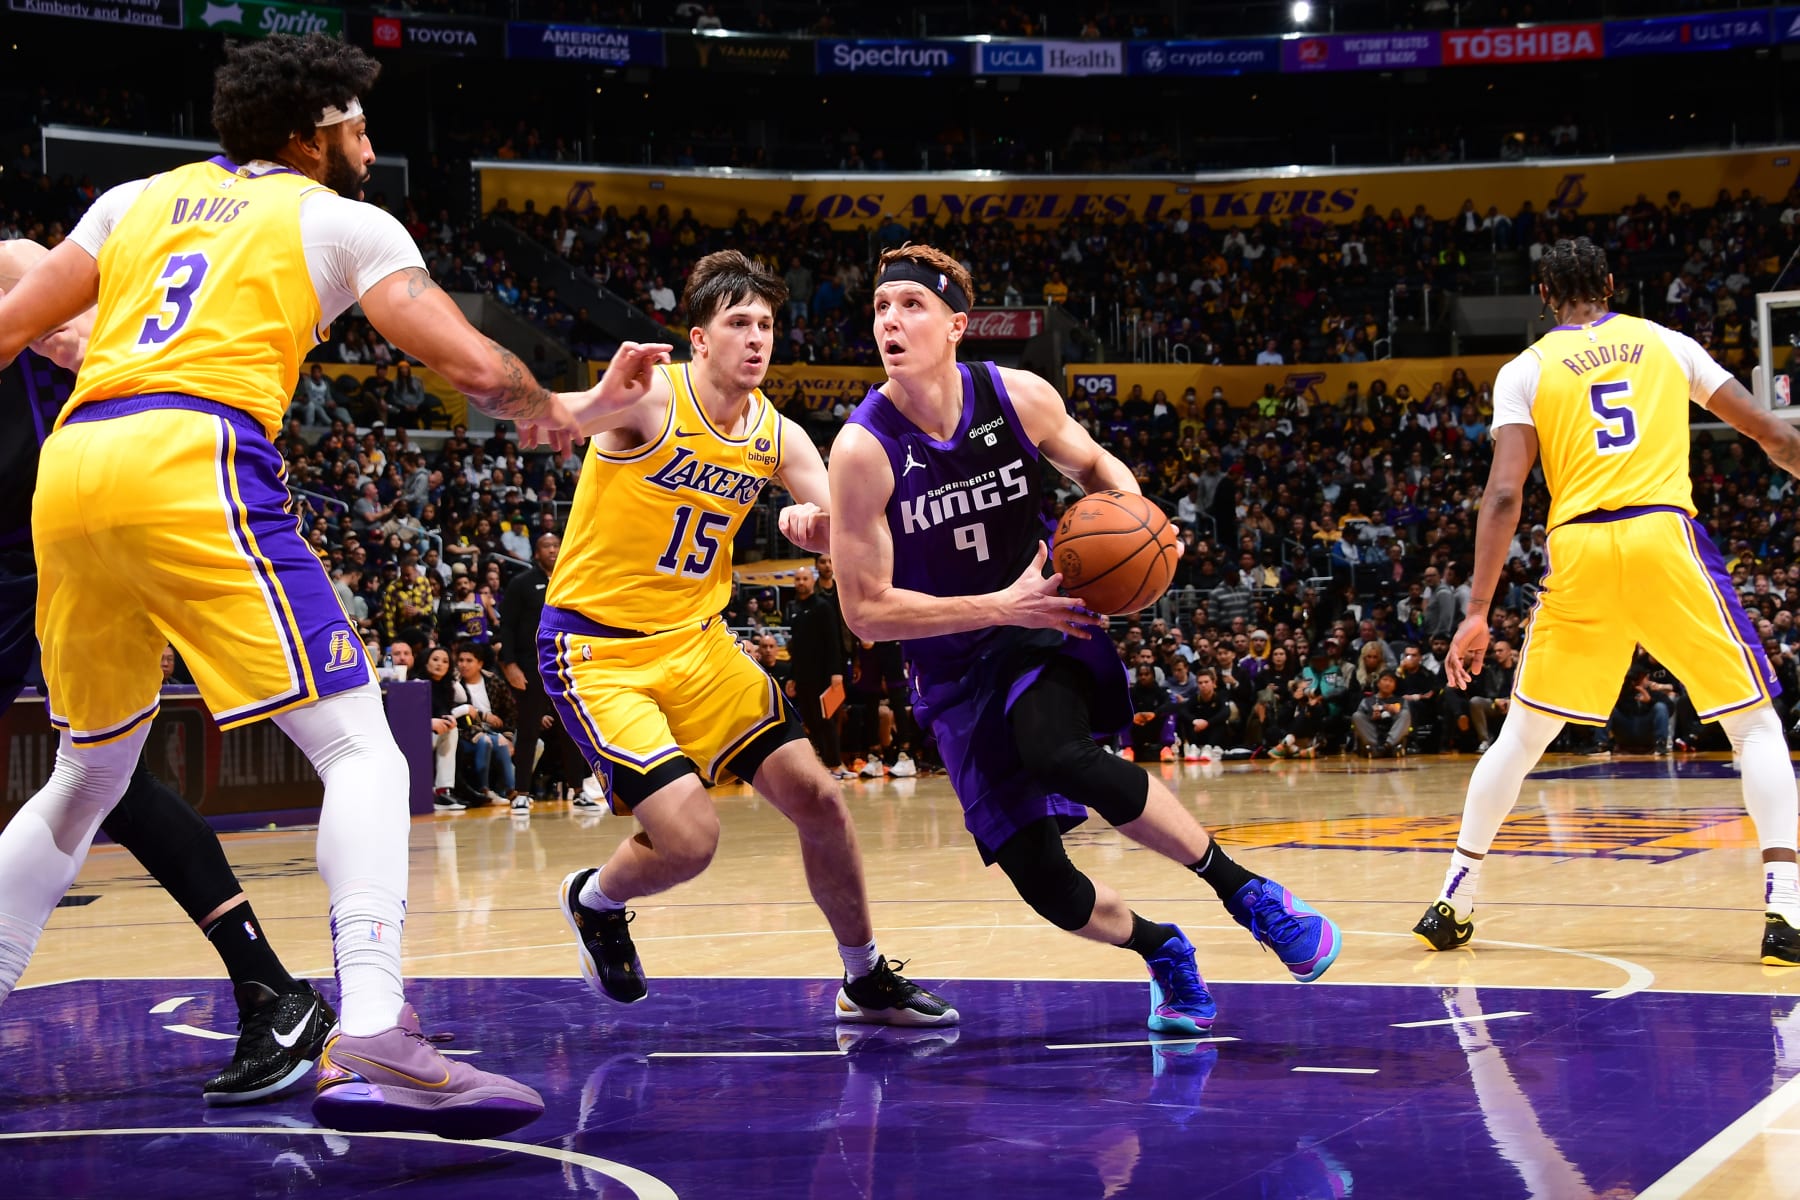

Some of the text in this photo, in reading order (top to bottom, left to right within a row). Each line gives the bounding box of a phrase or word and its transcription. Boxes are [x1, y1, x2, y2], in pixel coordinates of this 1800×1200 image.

[93, 7, 120, 21] and
[259, 5, 328, 34] Sprite
[407, 26, 478, 46] TOYOTA
[541, 29, 630, 48] AMERICAN
[1448, 29, 1596, 60] TOSHIBA
[1693, 21, 1764, 41] ULTRA
[554, 44, 631, 62] EXPRESS
[832, 43, 950, 71] Spectrum
[989, 49, 1116, 69] UCLA Health
[1168, 46, 1265, 67] crypto.com
[170, 197, 249, 225] DAVIS
[785, 188, 1359, 219] LOS ANGELES LAKERS
[136, 251, 210, 350] 3
[1562, 344, 1644, 376] REDDISH
[764, 379, 785, 390] OS
[968, 415, 1005, 439] dialpad
[1589, 380, 1640, 455] 5
[747, 452, 776, 465] bibigo
[644, 446, 769, 506] LAKERS
[927, 470, 996, 498] SACRAMENTO
[657, 505, 732, 579] 15
[953, 522, 990, 562] 9
